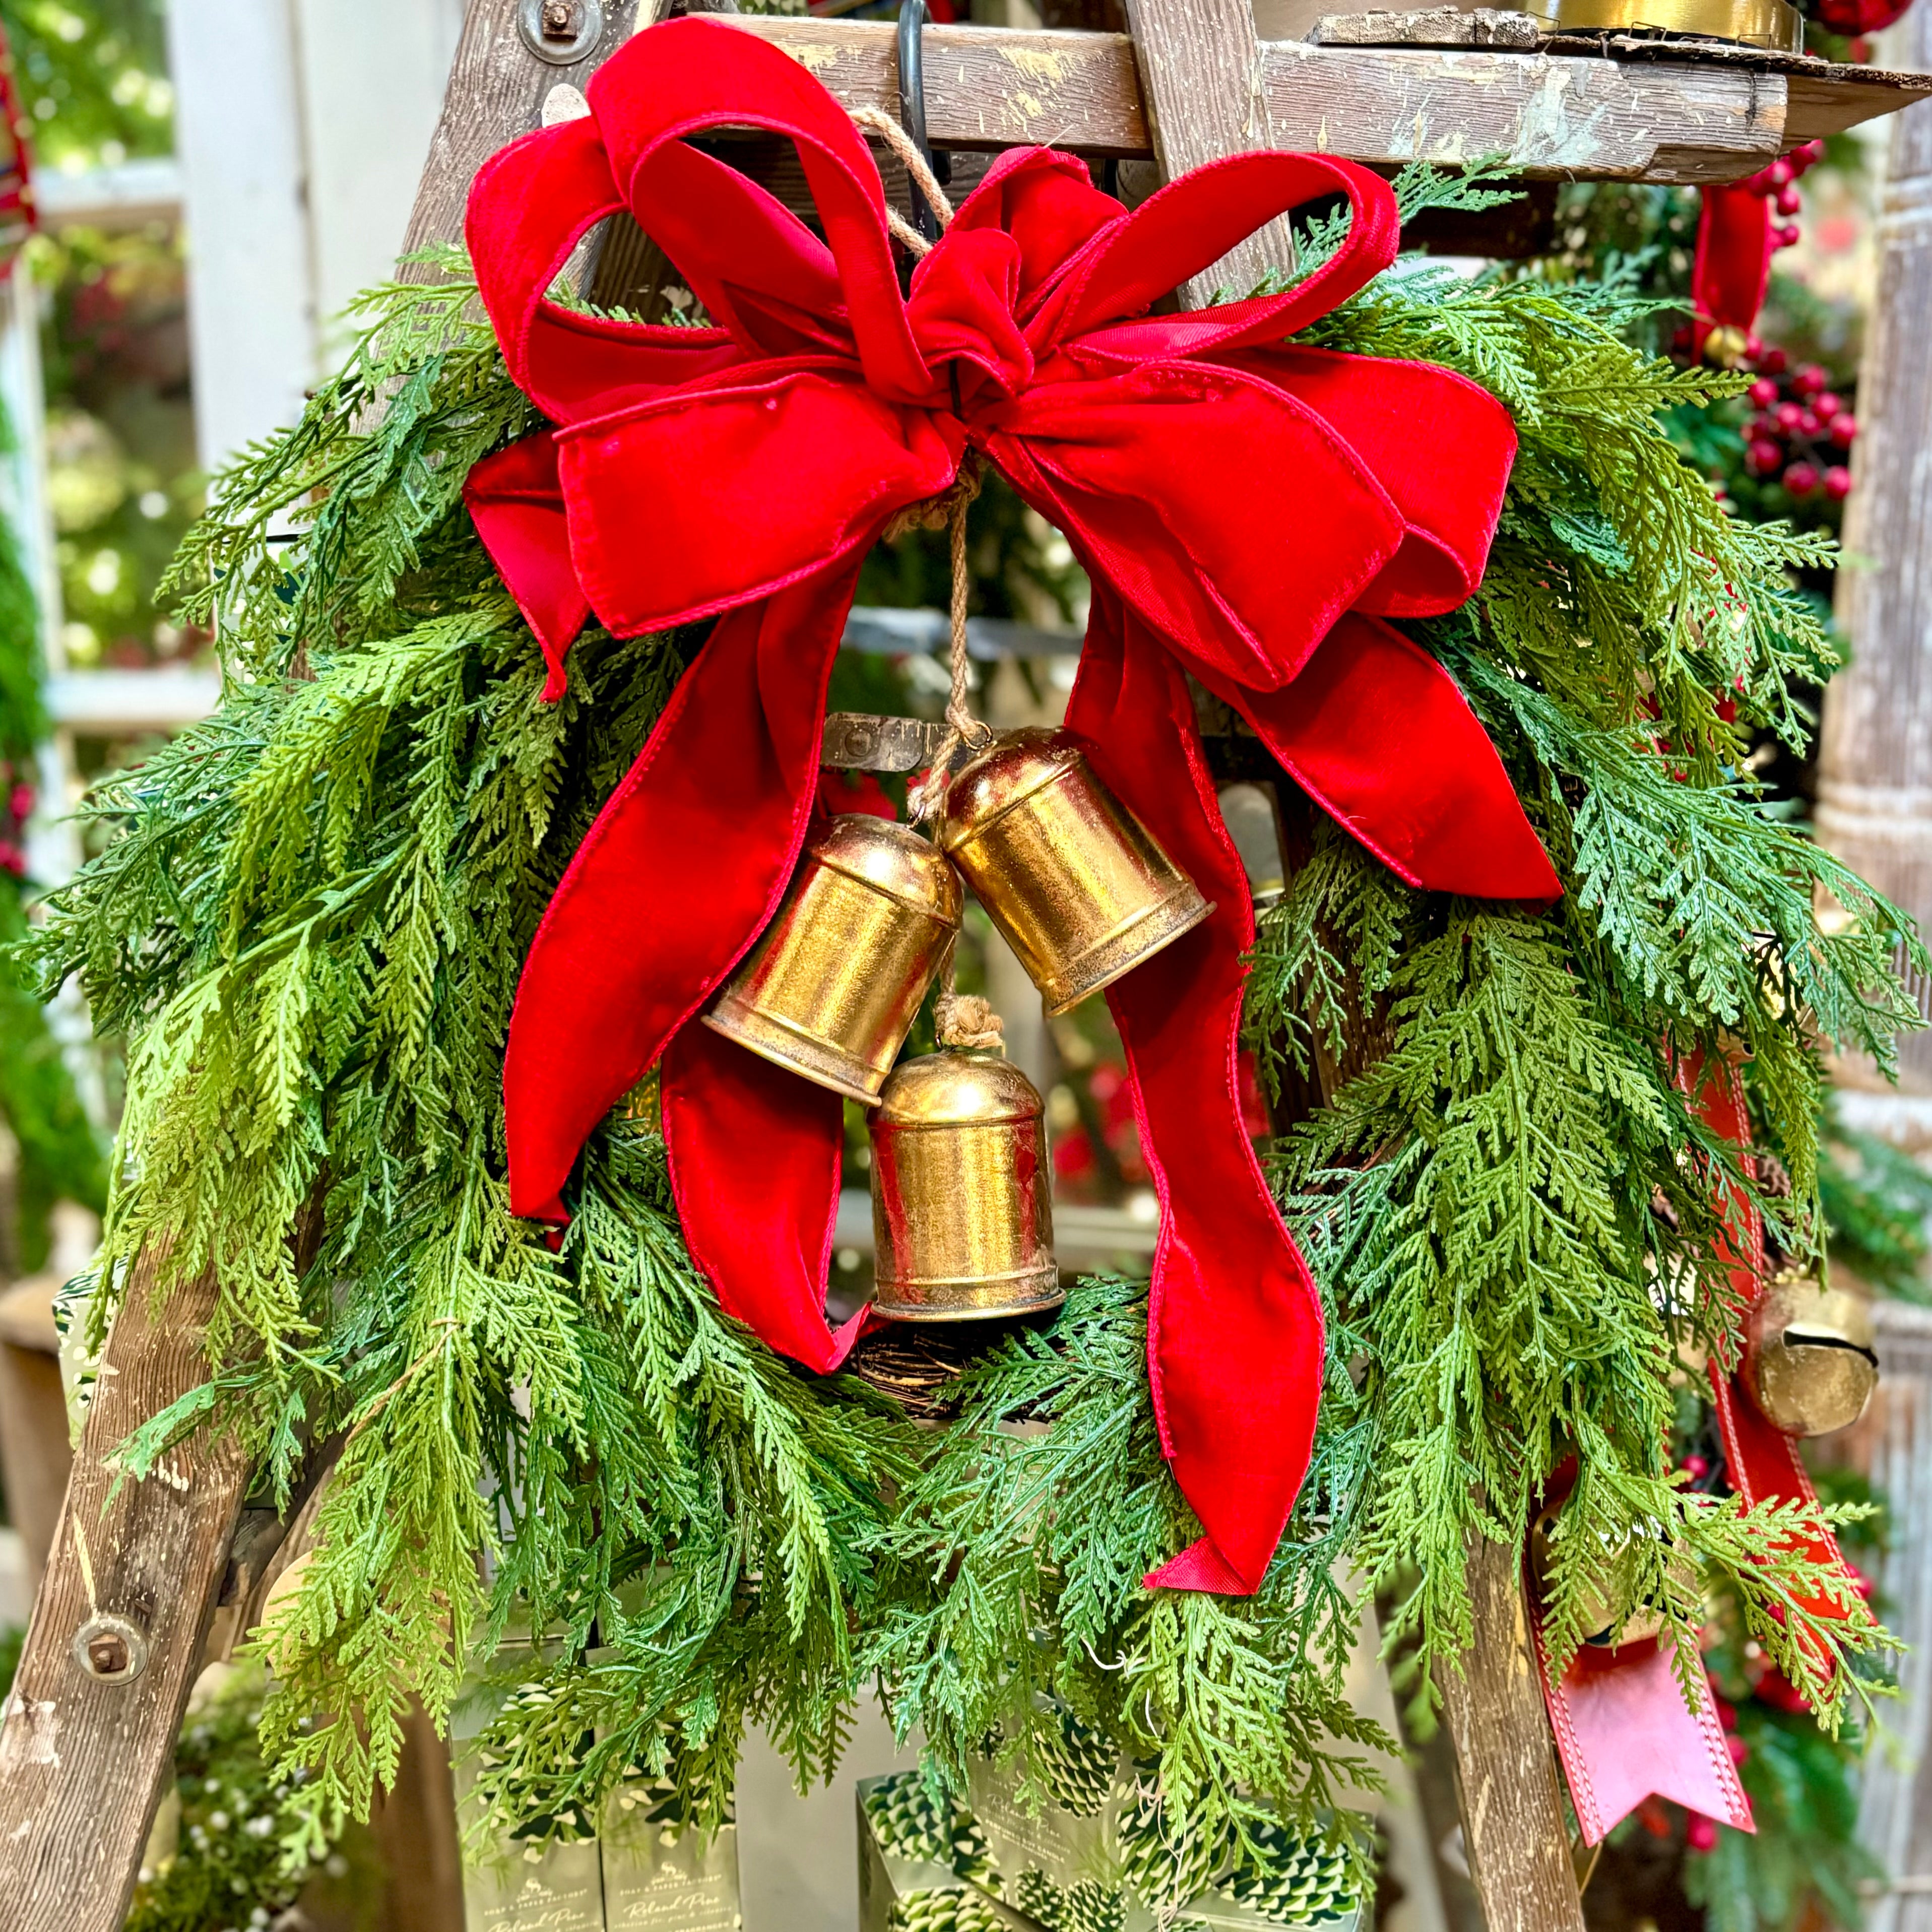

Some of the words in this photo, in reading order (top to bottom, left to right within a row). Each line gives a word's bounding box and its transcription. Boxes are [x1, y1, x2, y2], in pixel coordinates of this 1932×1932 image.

[548, 1907, 585, 1926] Pine
[623, 1895, 682, 1919] Roland
[682, 1892, 720, 1909] Pine
